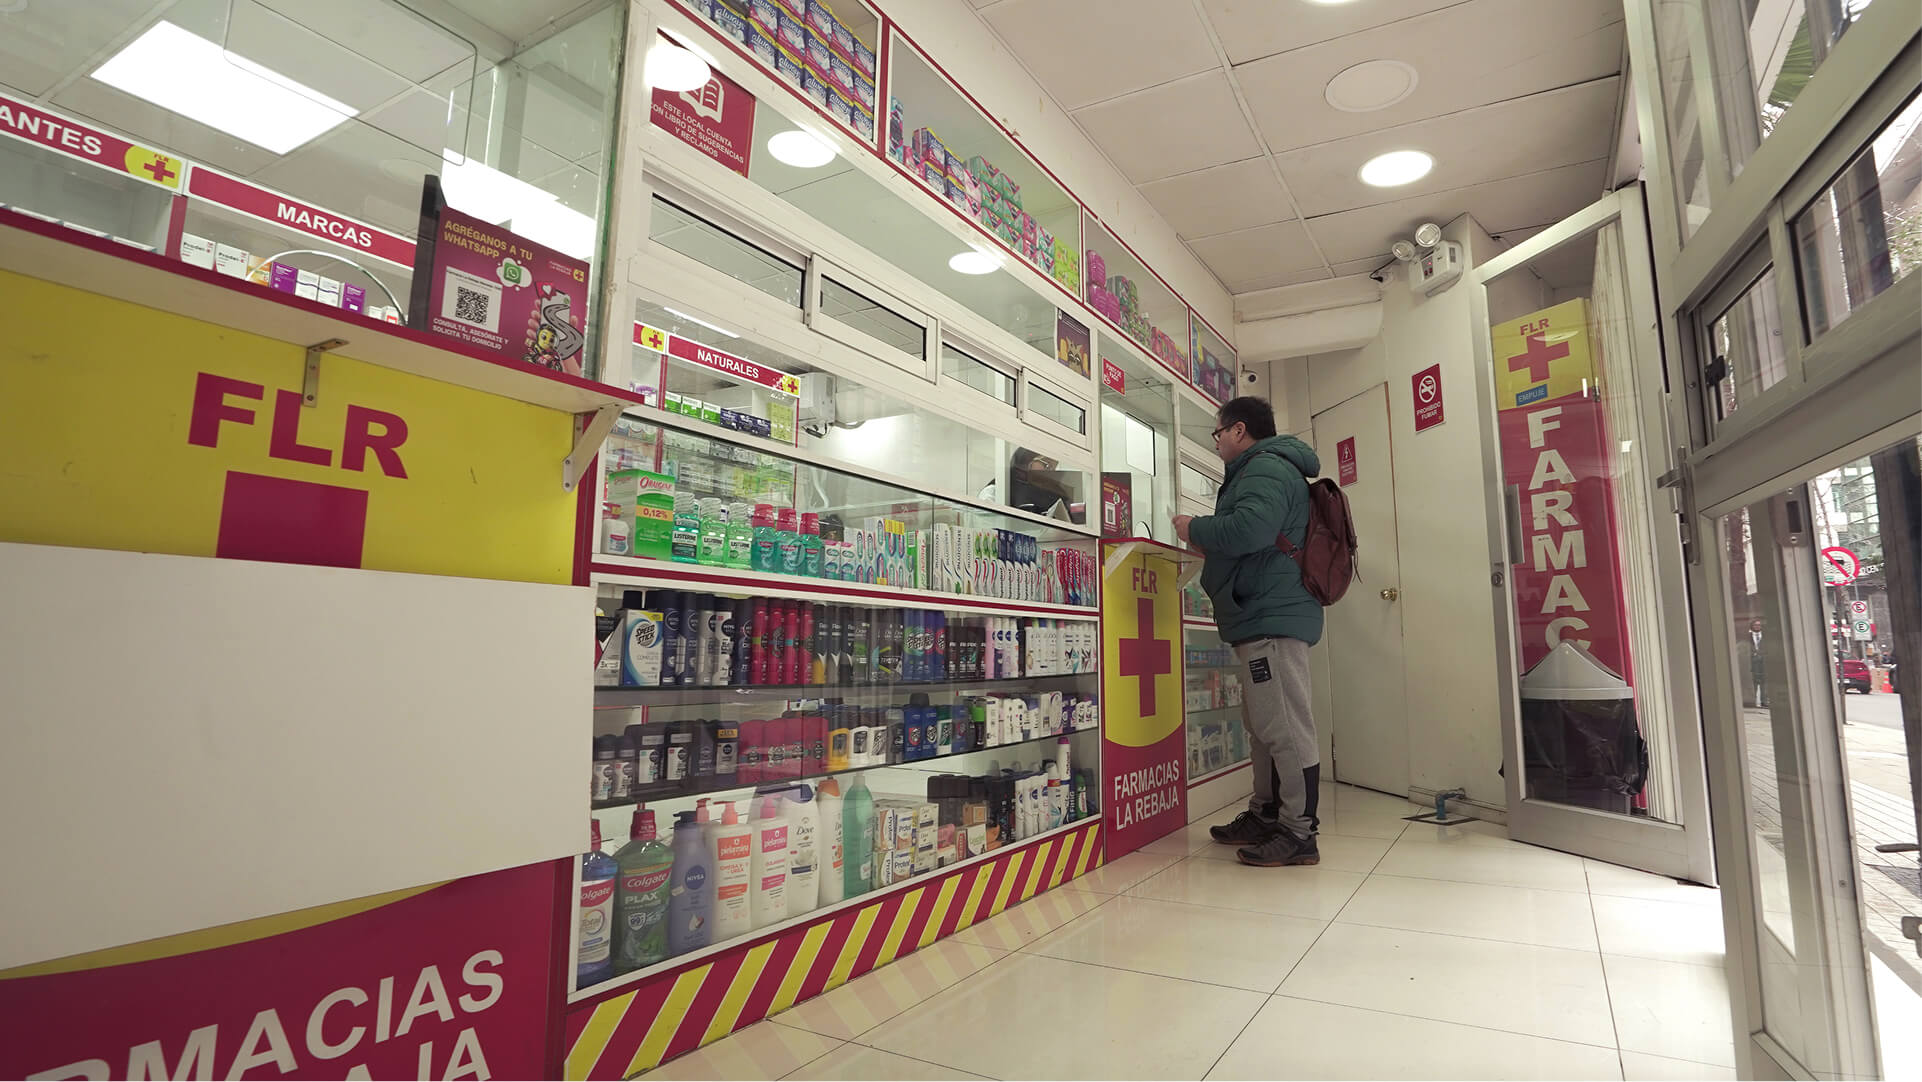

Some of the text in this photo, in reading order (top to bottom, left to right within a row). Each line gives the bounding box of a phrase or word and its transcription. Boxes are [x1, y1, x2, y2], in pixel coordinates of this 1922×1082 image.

[0, 105, 102, 156] ANTES
[663, 100, 733, 148] ESTE LOCAL CUENTA
[665, 112, 686, 129] LIBRO
[688, 125, 697, 136] DE
[698, 131, 744, 164] SUGERENCIAS
[674, 126, 718, 158] Y RECLAMOS
[277, 202, 372, 248] MARCAS
[444, 232, 500, 258] WHATSAPP
[445, 221, 532, 260] AGRÉGANOS A TU
[1520, 318, 1550, 336] FLR
[698, 349, 760, 379] NATURALES
[1416, 401, 1441, 416] PROHIBIDO
[1518, 388, 1546, 403] EMPUJE
[188, 372, 408, 480] FLR
[1422, 410, 1438, 420] FUMAR
[1132, 568, 1158, 594] FLR
[636, 624, 655, 636] SPEED
[638, 632, 655, 644] STICK
[1114, 760, 1180, 800] FARMACIAS
[1116, 802, 1133, 830] LA
[1136, 786, 1179, 822] REBAJA
[627, 873, 667, 888] Colgate
[686, 874, 704, 882] NIVEA
[582, 887, 610, 900] olgate
[625, 892, 658, 904] PLAX
[25, 949, 504, 1081] MACIAS
